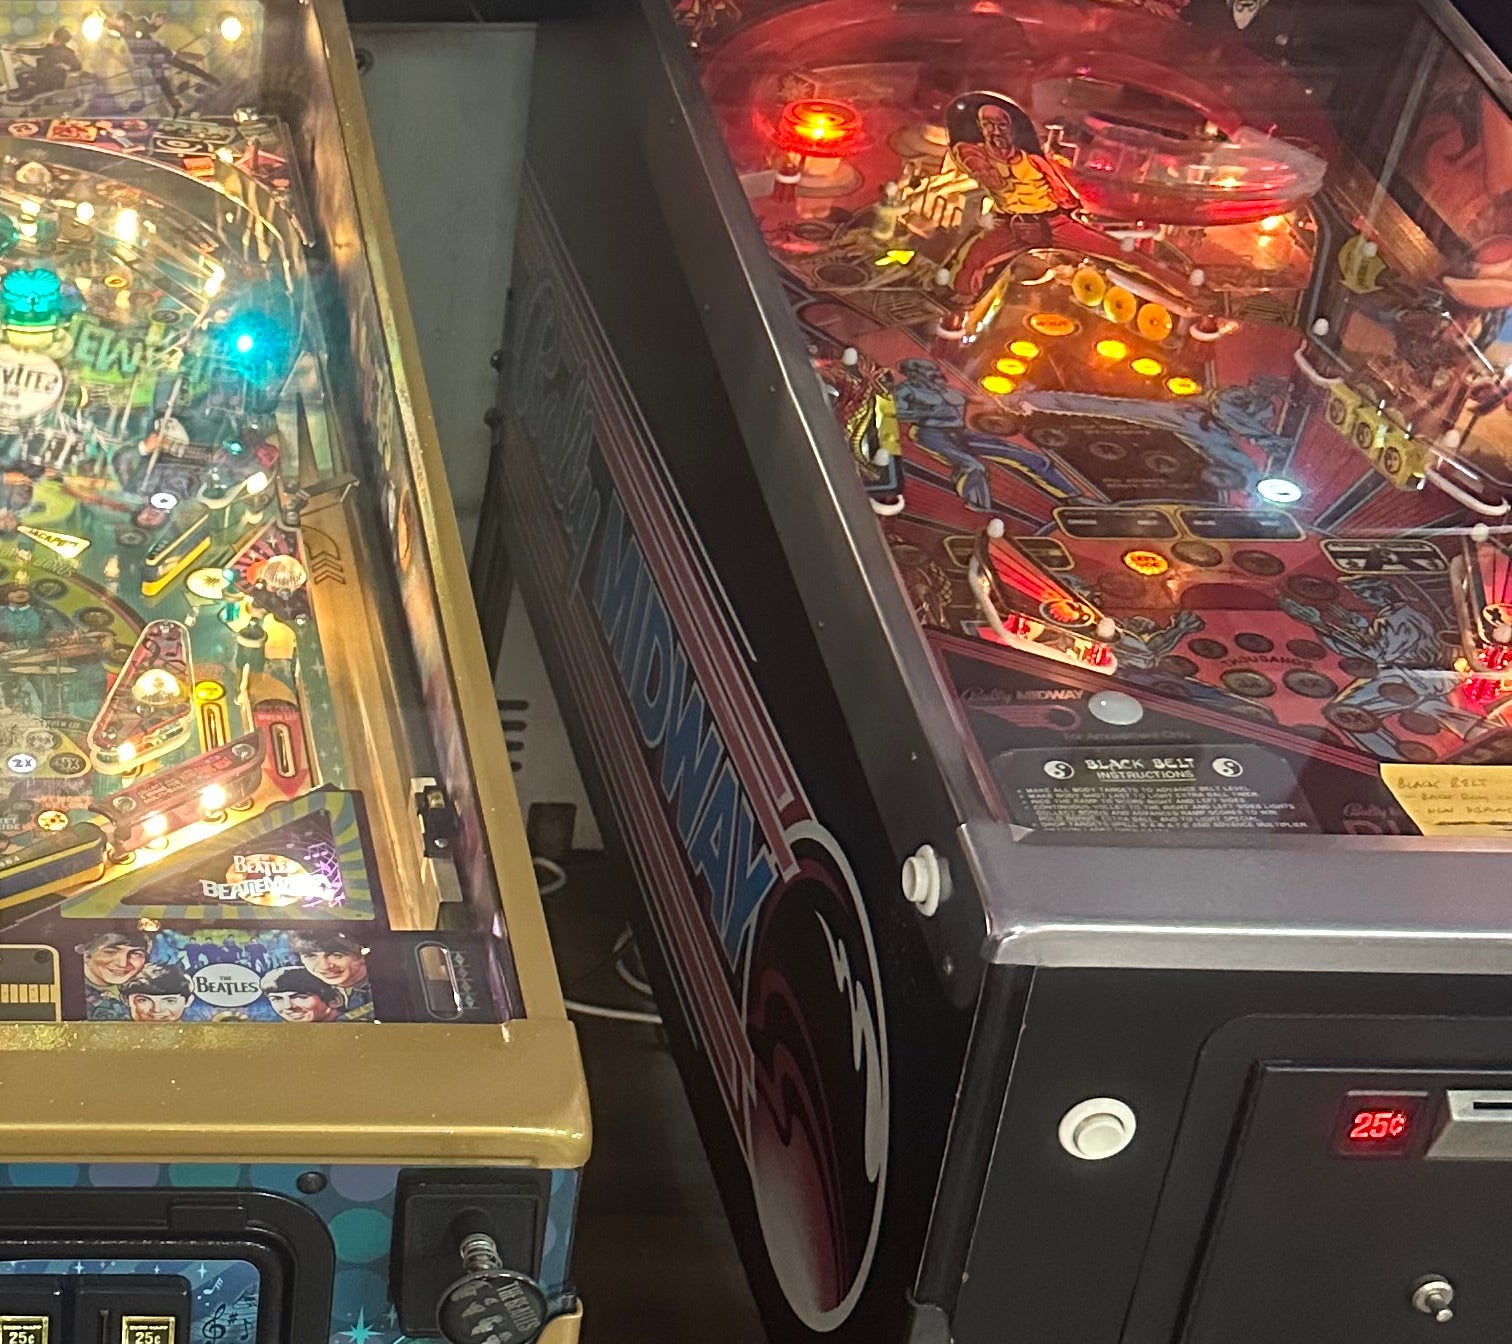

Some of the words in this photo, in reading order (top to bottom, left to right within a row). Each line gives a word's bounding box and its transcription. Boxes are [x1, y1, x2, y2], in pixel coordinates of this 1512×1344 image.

[1016, 689, 1085, 701] MIDWAY
[593, 486, 780, 971] MIDWAY
[1085, 758, 1143, 771] BLACK
[1152, 757, 1195, 770] BELT
[1096, 771, 1196, 780] INSTRUCTIONS
[196, 975, 260, 996] BEATLES
[1350, 1112, 1406, 1139] 25¢
